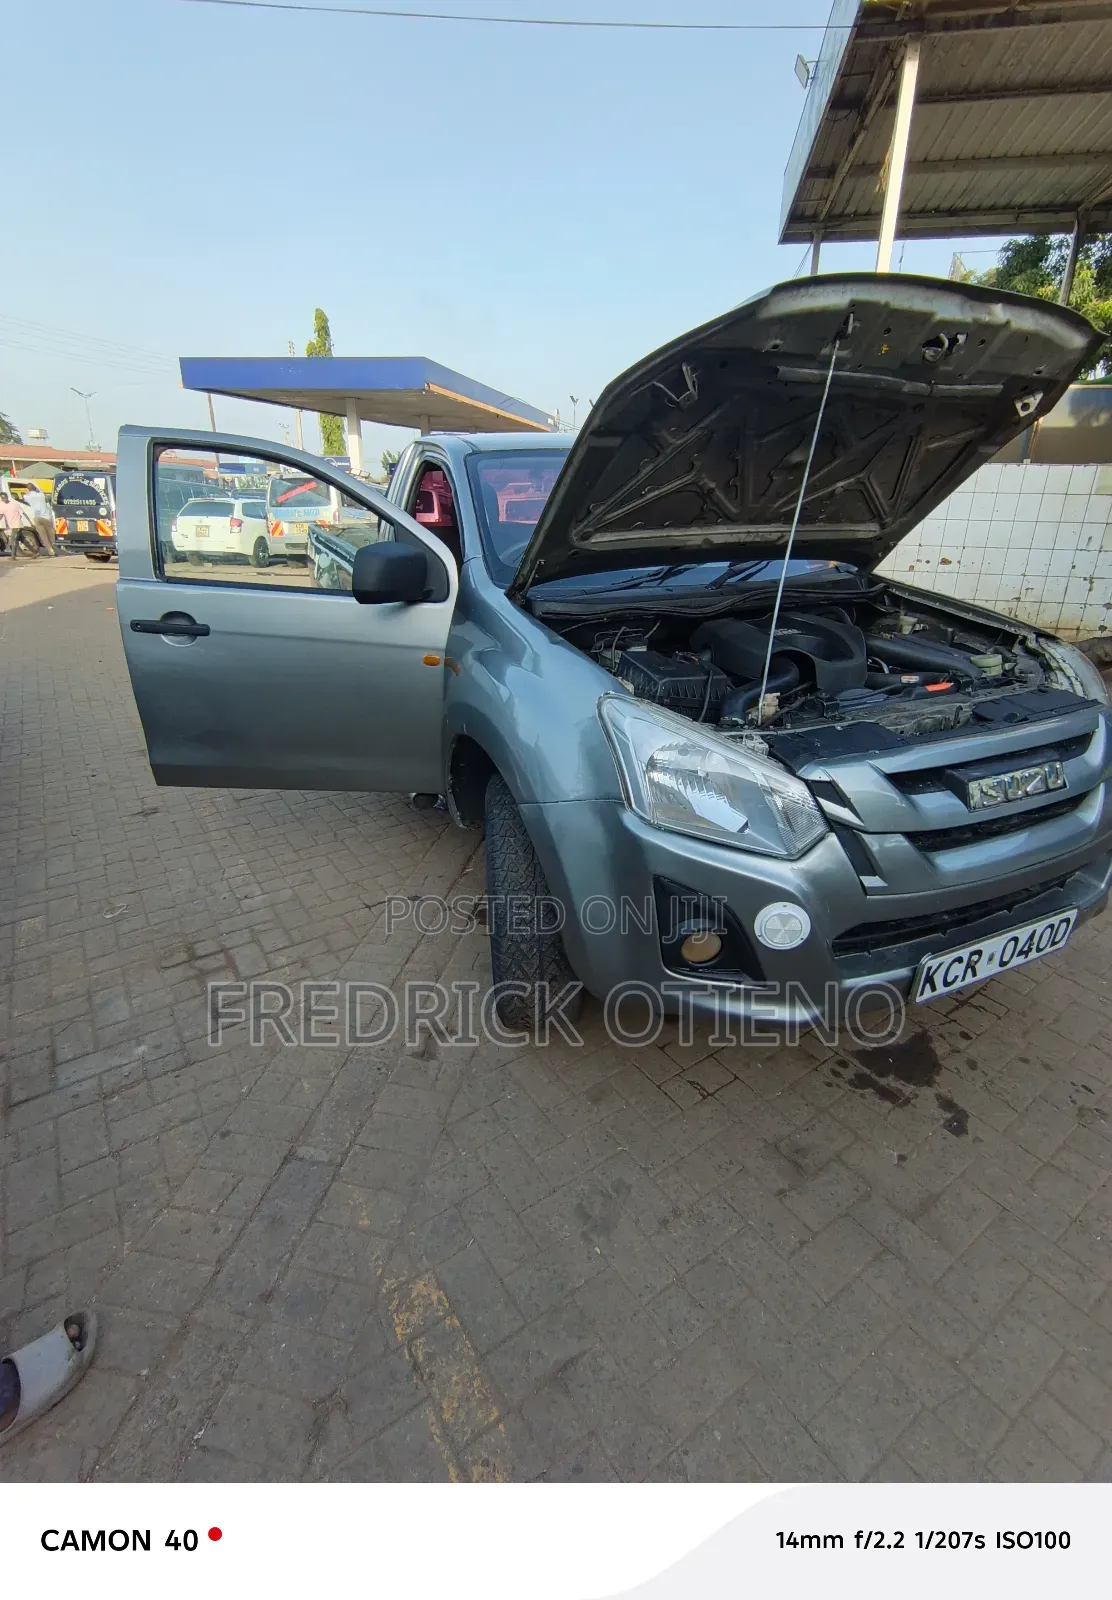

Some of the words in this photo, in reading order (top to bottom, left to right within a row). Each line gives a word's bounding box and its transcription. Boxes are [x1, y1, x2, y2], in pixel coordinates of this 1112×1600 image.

[968, 761, 1065, 810] ISUZU
[918, 948, 983, 997] KCR
[998, 917, 1071, 968] 040D
